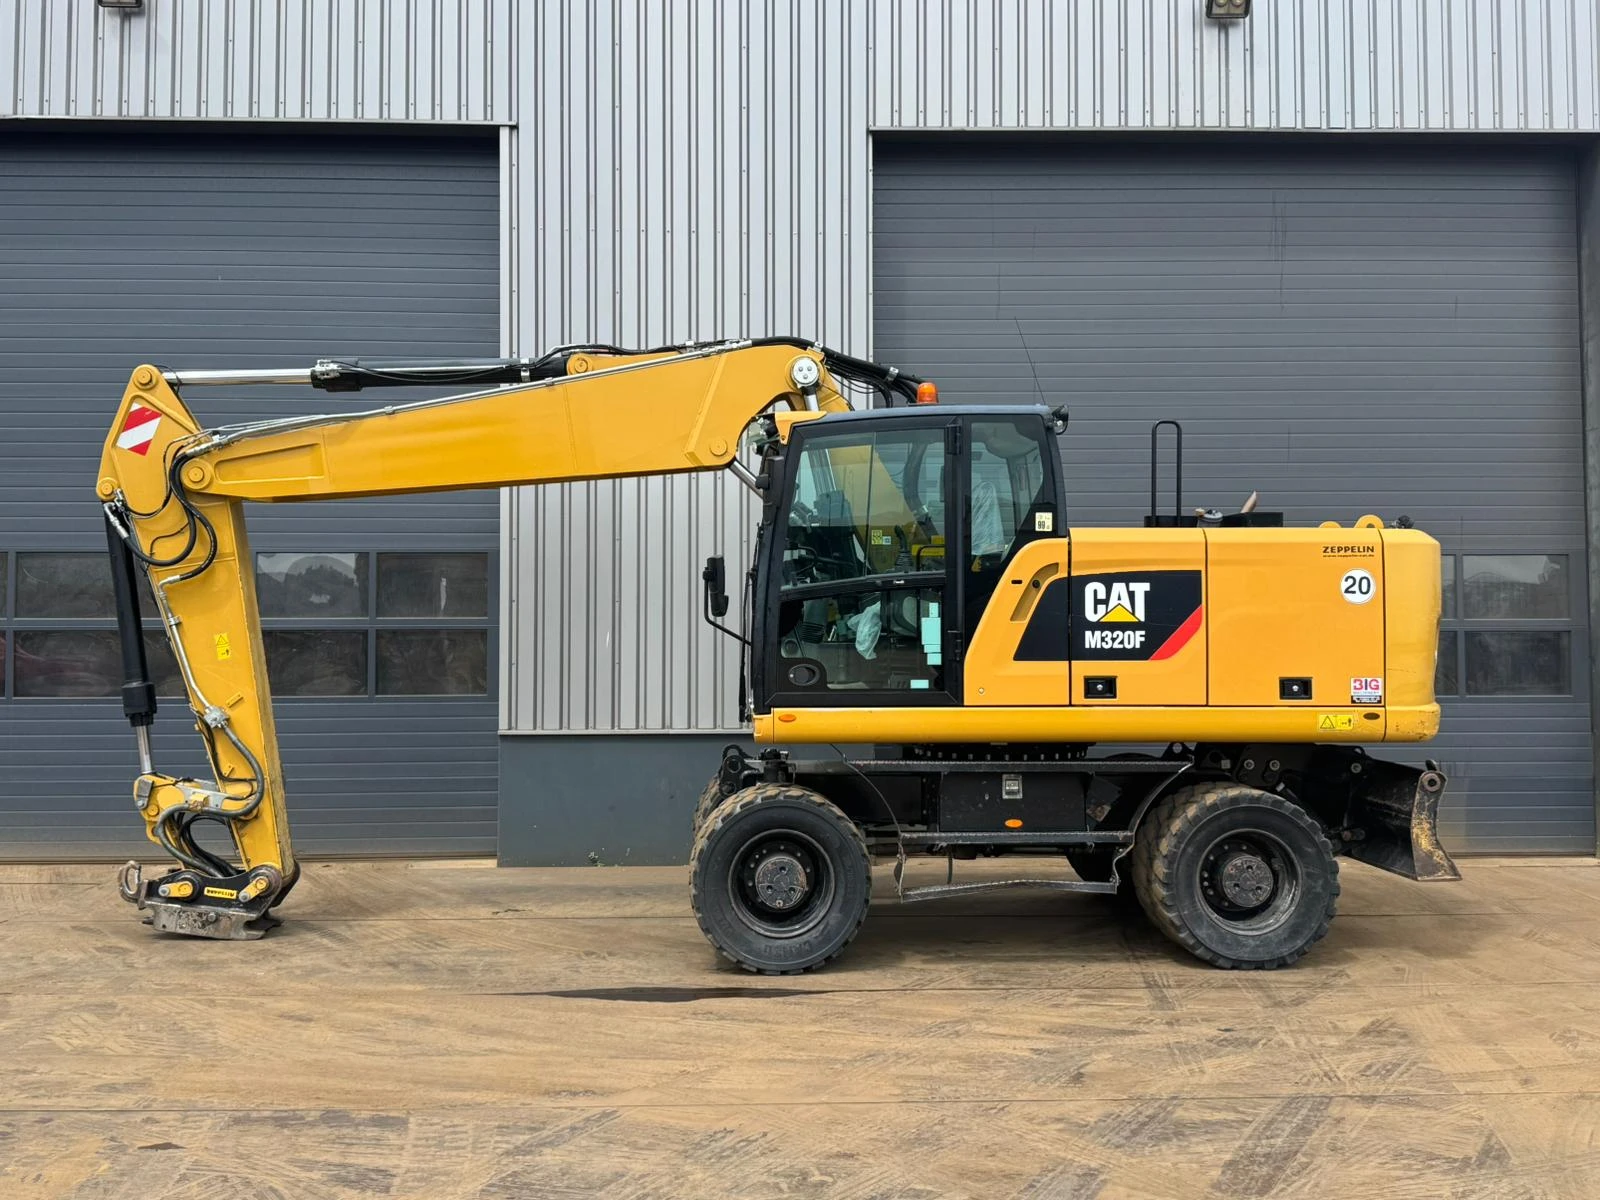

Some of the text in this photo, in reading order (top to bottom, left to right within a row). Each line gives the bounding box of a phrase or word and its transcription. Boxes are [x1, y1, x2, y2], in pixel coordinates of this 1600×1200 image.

[1322, 545, 1375, 554] ZEPPELIN
[1343, 575, 1371, 595] 20
[1084, 581, 1151, 622] CAT
[1084, 630, 1146, 649] M320F
